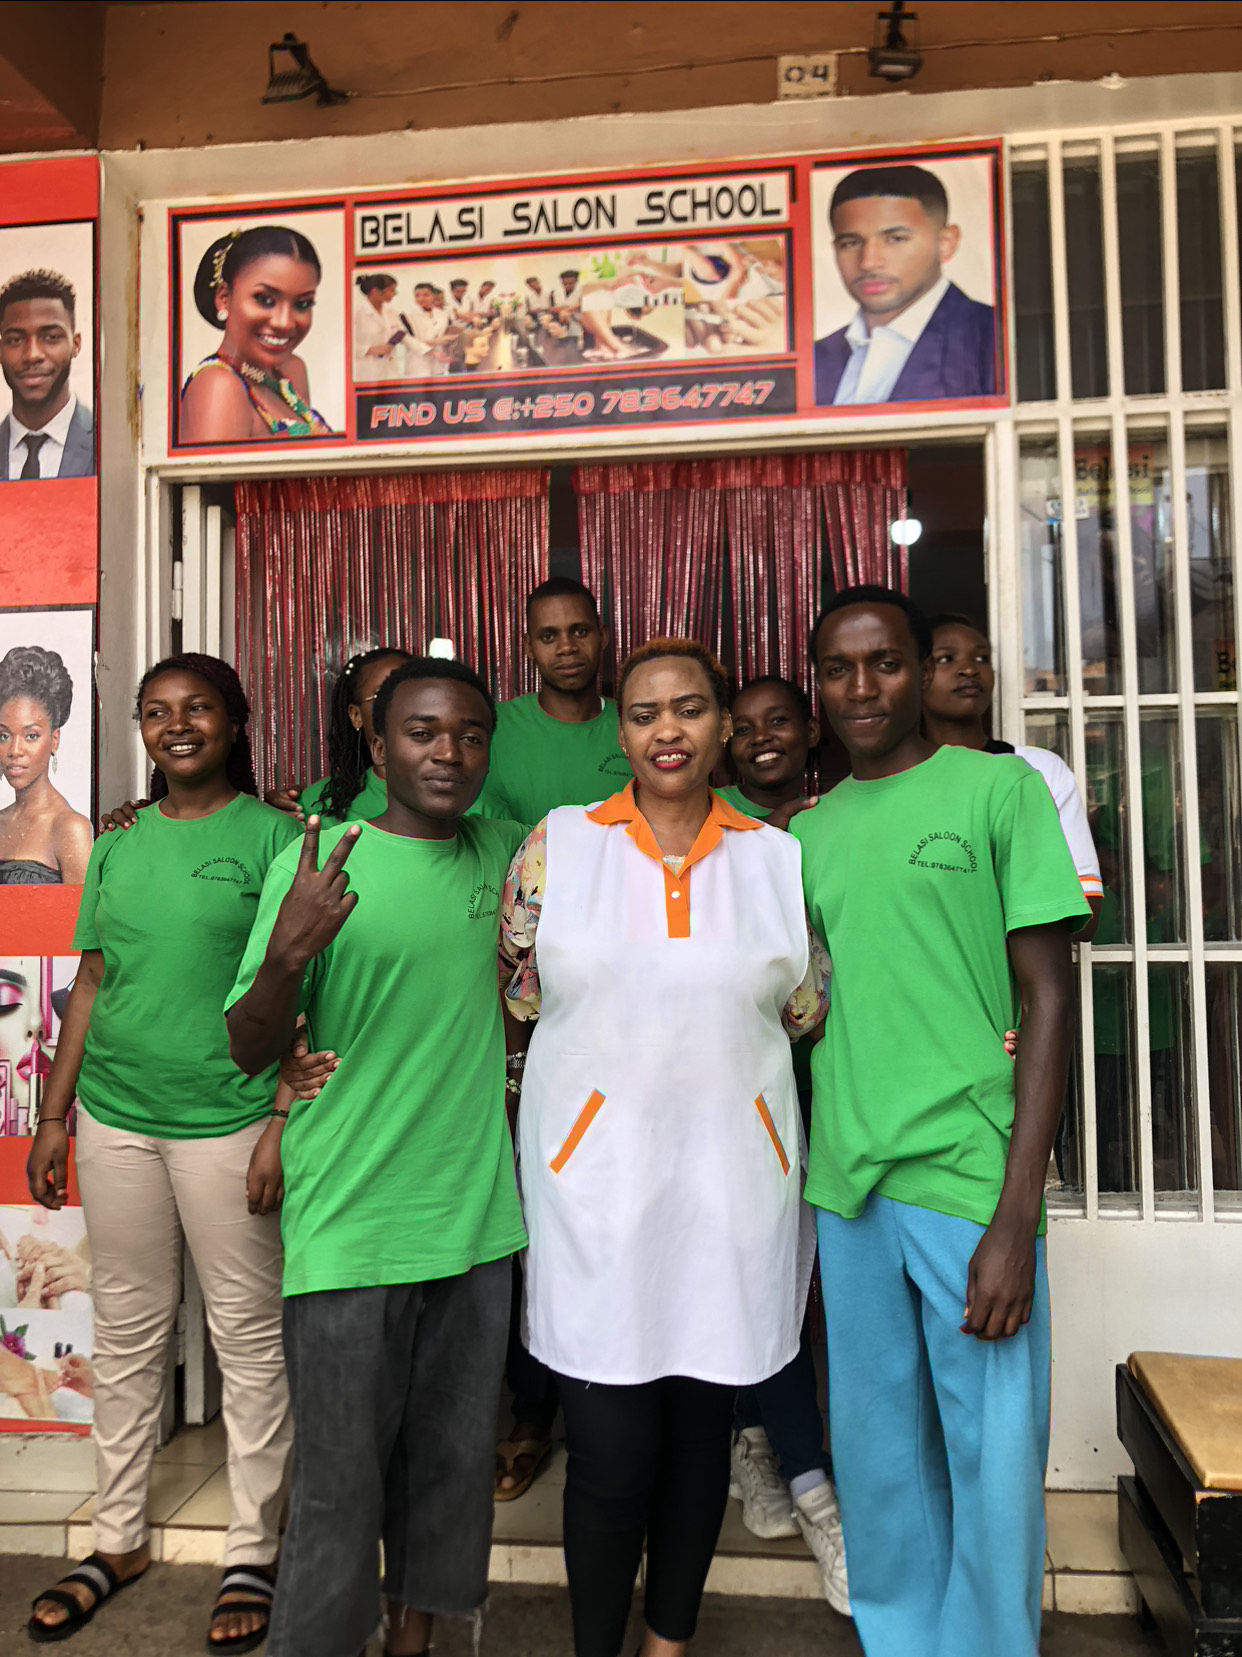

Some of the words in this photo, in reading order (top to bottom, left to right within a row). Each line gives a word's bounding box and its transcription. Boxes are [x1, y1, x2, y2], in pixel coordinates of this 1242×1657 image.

[361, 206, 484, 248] BELASI
[503, 194, 617, 237] SALON
[637, 182, 782, 227] SCHOOL
[371, 402, 437, 428] FIND
[443, 398, 487, 424] US
[601, 380, 776, 415] 783647747
[908, 838, 929, 865] BELASI
[928, 831, 962, 843] SALOON
[960, 840, 978, 873] SCHOOL
